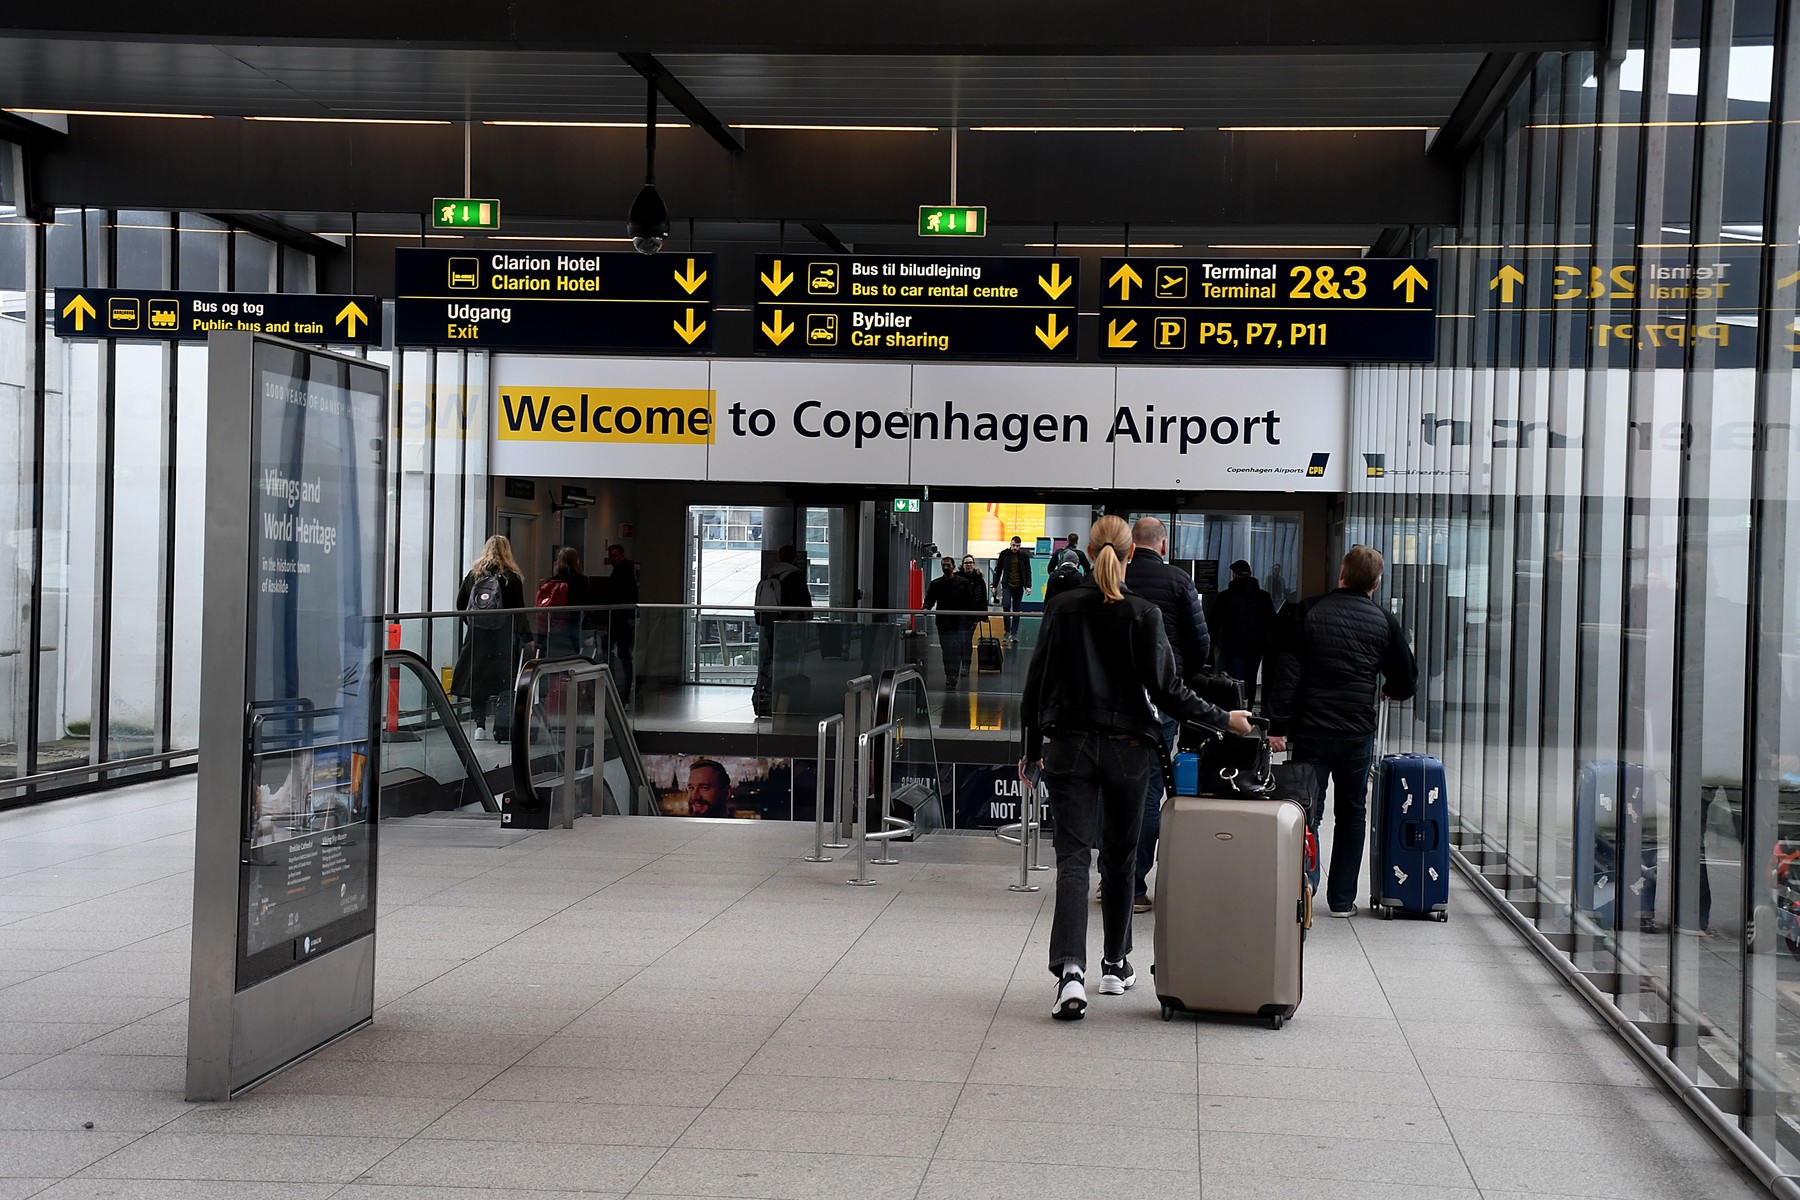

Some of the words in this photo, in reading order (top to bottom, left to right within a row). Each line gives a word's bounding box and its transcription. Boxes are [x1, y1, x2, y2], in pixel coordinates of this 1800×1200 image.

[492, 254, 551, 271] Clarion
[557, 256, 600, 272] Hotel
[852, 263, 878, 276] Bus
[882, 263, 896, 276] til
[900, 263, 982, 279] biludlejning
[1202, 264, 1277, 280] Terminal
[491, 275, 551, 291] Clarion
[557, 276, 600, 292] Hotel
[852, 283, 878, 296] Bus
[882, 284, 896, 297] to
[901, 286, 923, 297] car
[928, 284, 968, 297] rental
[973, 286, 1019, 298] centre
[1202, 283, 1276, 299] Terminal
[1289, 266, 1367, 299] 2&3
[193, 300, 218, 313] Bus
[222, 303, 239, 316] og
[243, 302, 264, 316] tog
[448, 304, 512, 323] Udgang
[237, 320, 261, 332] bus
[265, 321, 290, 333] and
[294, 322, 323, 334] train
[852, 312, 912, 331] Bybiler
[447, 324, 479, 339] Exit
[851, 331, 880, 347] Car
[887, 332, 949, 350] sharing
[1199, 323, 1239, 348] P5,
[1246, 323, 1283, 348] P7,
[1290, 323, 1327, 346] P11
[265, 382, 284, 401] 1000
[286, 387, 306, 407] YEARS
[309, 394, 319, 410] OF
[502, 393, 713, 435] Welcome
[728, 402, 776, 437] to
[793, 400, 1089, 452] Copenhagen
[1105, 404, 1281, 455] Airport
[1226, 466, 1273, 475] Copenhagen
[1274, 467, 1304, 475] Airports
[1308, 466, 1324, 475] CPH
[265, 469, 300, 509] Vikings
[302, 477, 320, 504] and
[264, 512, 293, 542] World
[295, 517, 336, 554] Heritage
[994, 779, 1050, 798] CLAN
[990, 801, 1016, 820] NOT
